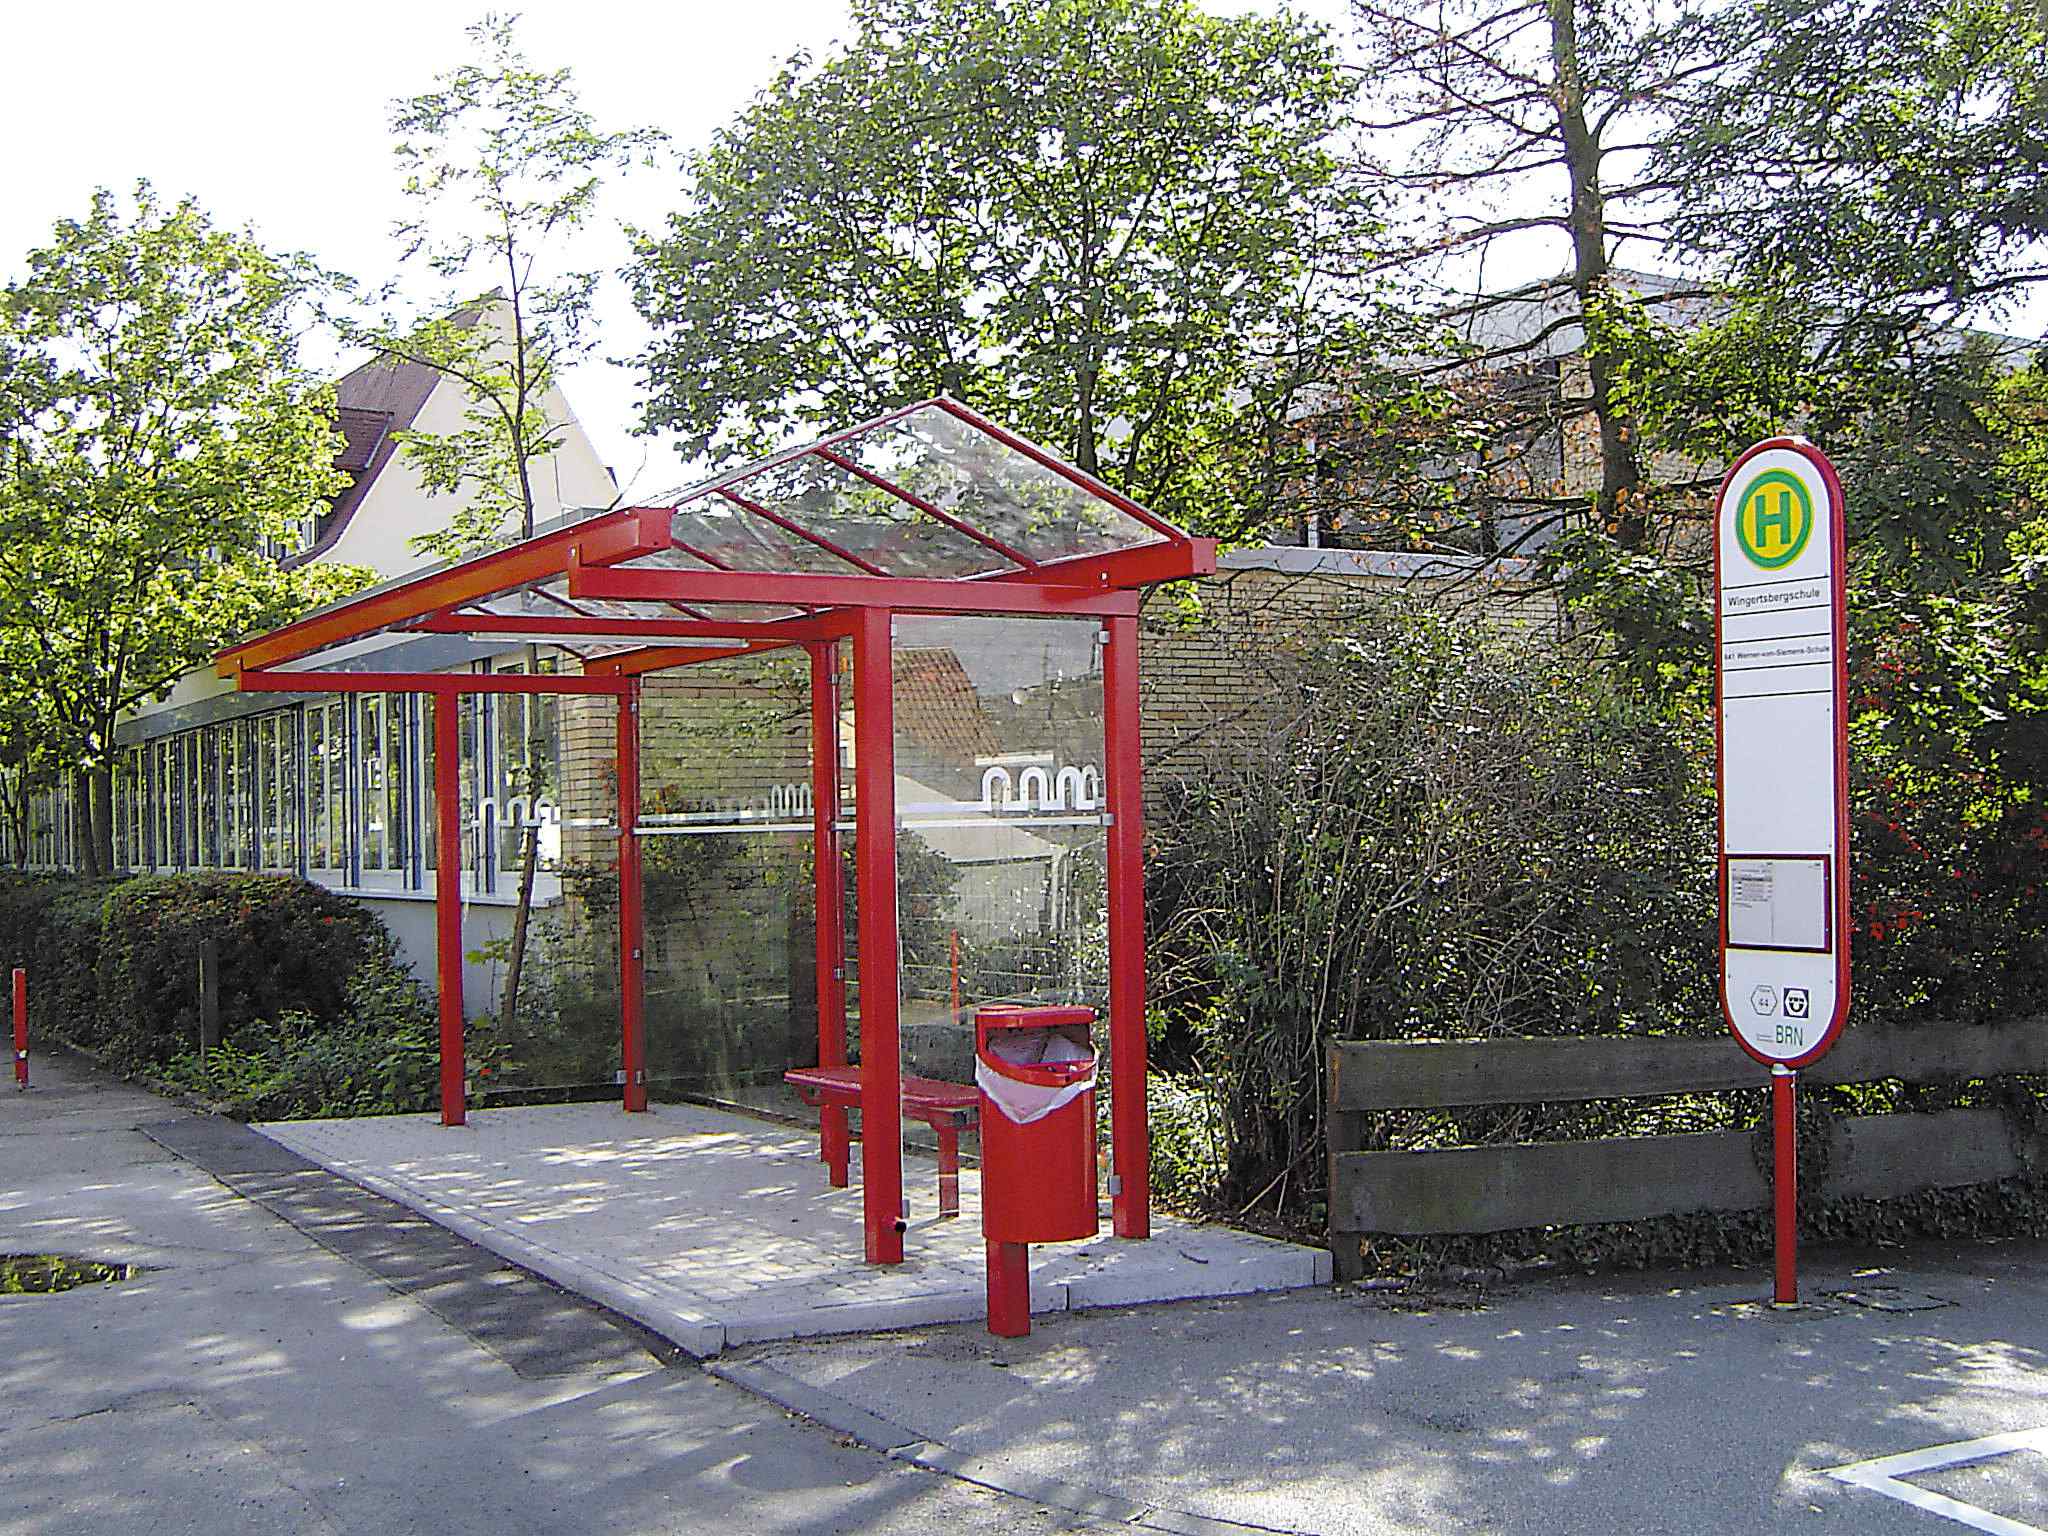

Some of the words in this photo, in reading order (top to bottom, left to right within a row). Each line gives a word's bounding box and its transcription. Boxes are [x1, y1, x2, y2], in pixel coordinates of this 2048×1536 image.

[1756, 491, 1791, 547] H
[1728, 588, 1820, 607] Wingertsbergschule
[1775, 1024, 1803, 1046] BRN
